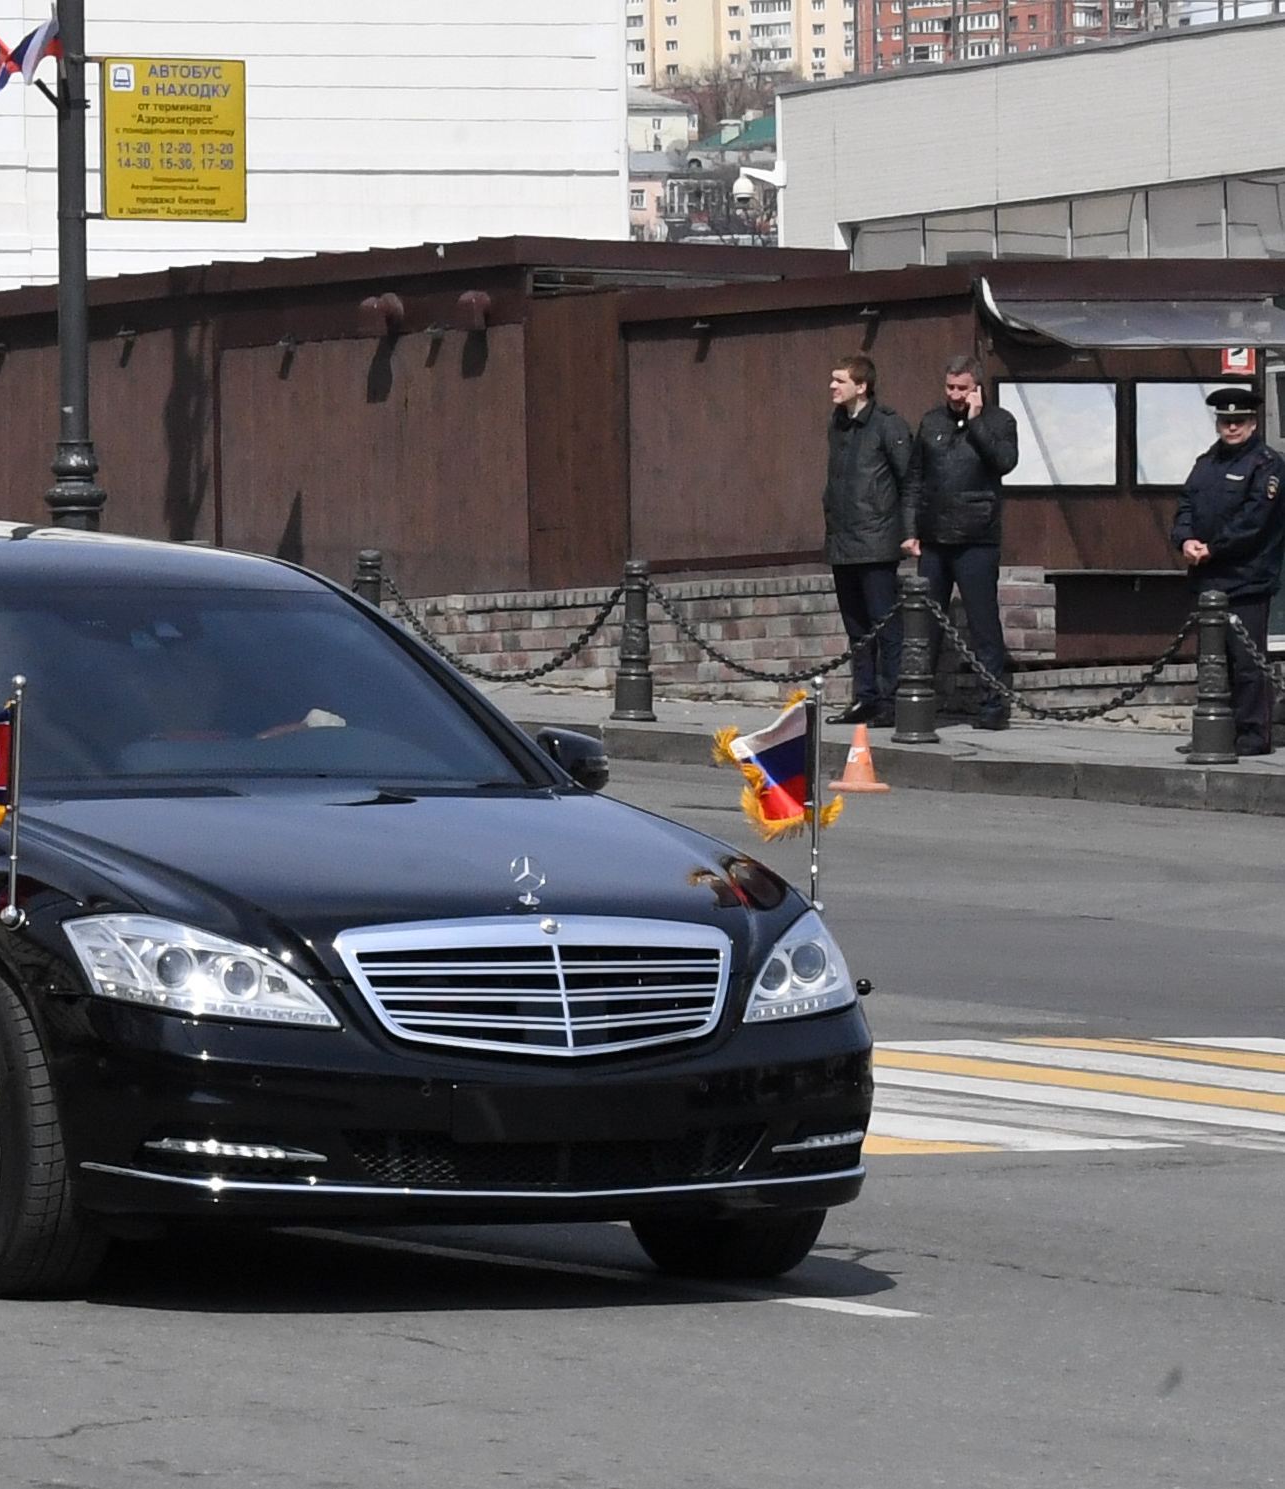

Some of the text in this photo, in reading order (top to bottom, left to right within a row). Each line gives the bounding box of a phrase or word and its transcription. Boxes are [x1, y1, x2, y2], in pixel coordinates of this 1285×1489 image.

[148, 64, 223, 79] АВТОБУС
[142, 83, 231, 99] в НАХОДКУ
[153, 103, 212, 112] терминала
[131, 114, 219, 126] "Аэроэкспресс"
[201, 143, 234, 155] 13-20
[136, 197, 175, 205] продажа
